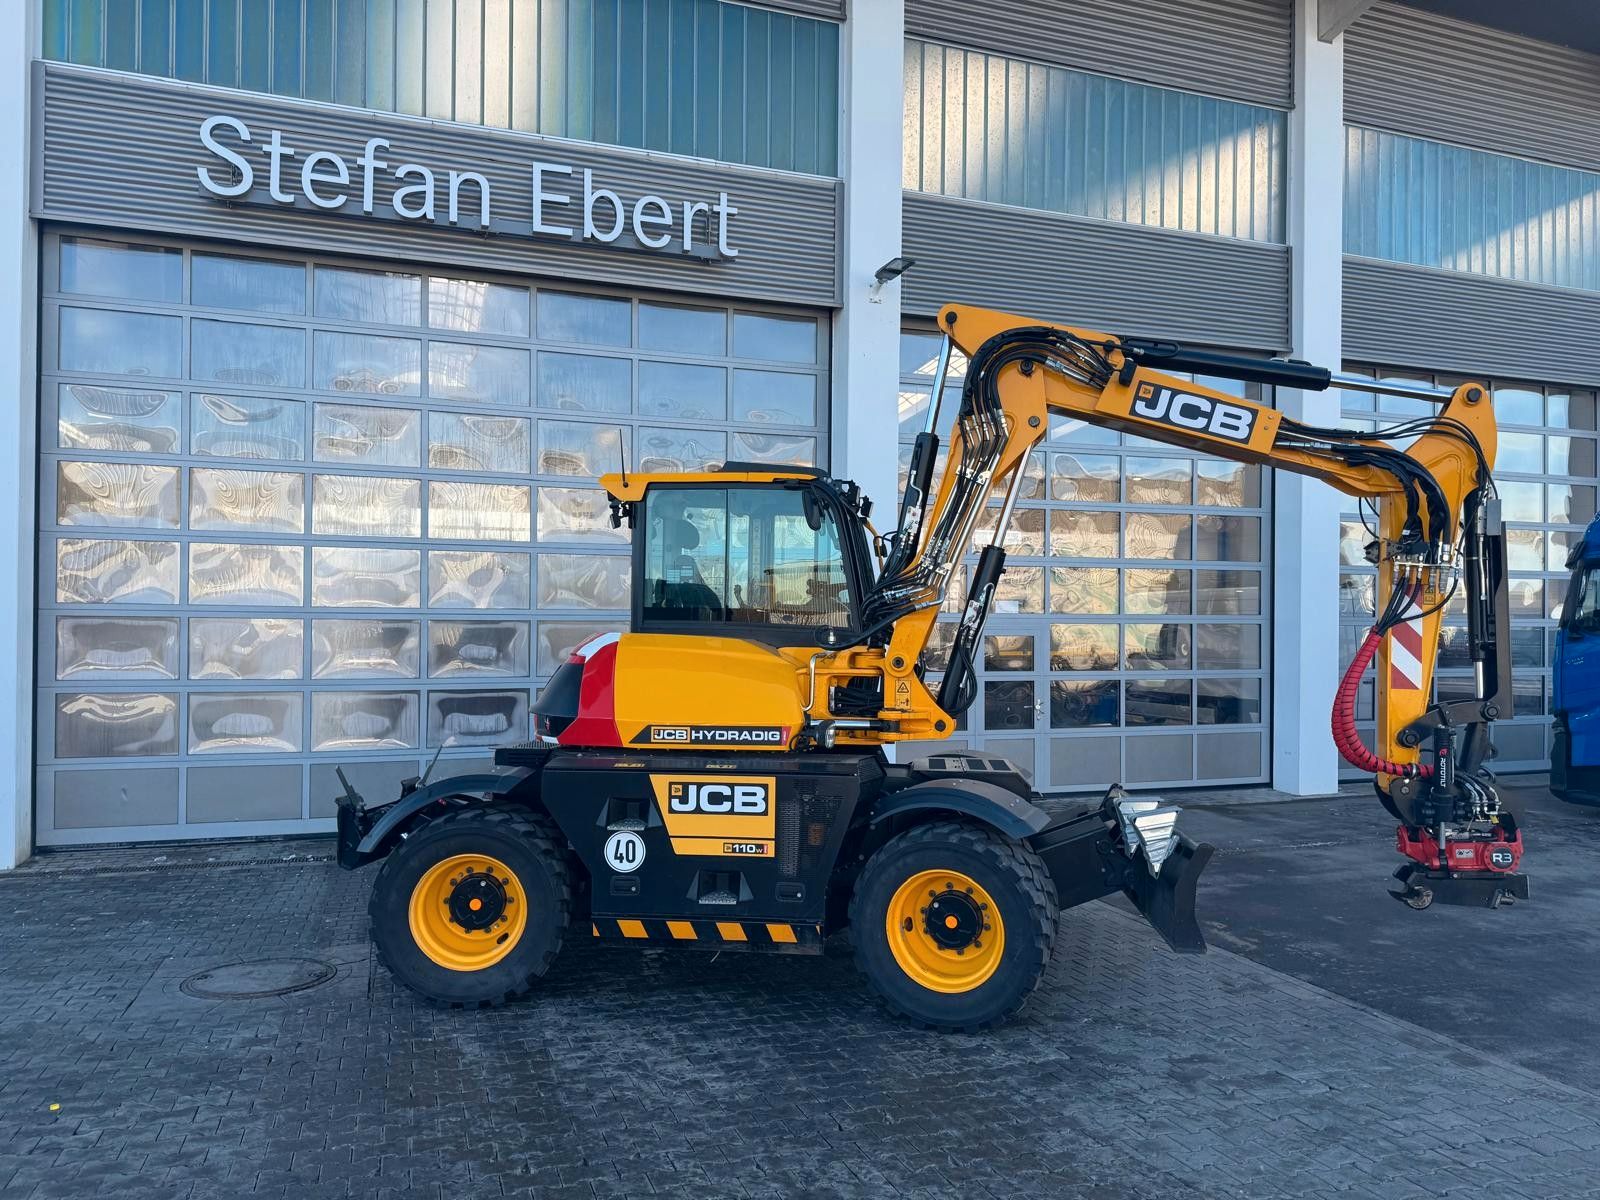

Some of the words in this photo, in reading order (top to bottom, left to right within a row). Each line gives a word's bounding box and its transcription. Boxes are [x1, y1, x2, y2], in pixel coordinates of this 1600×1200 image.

[197, 115, 490, 228] Stefan
[532, 161, 739, 257] Ebert
[1134, 388, 1253, 440] JCB
[654, 729, 687, 740] JCB
[691, 730, 780, 741] HYDRADIG
[670, 784, 766, 813] JCB
[613, 839, 637, 864] 40
[1492, 852, 1513, 864] R3
